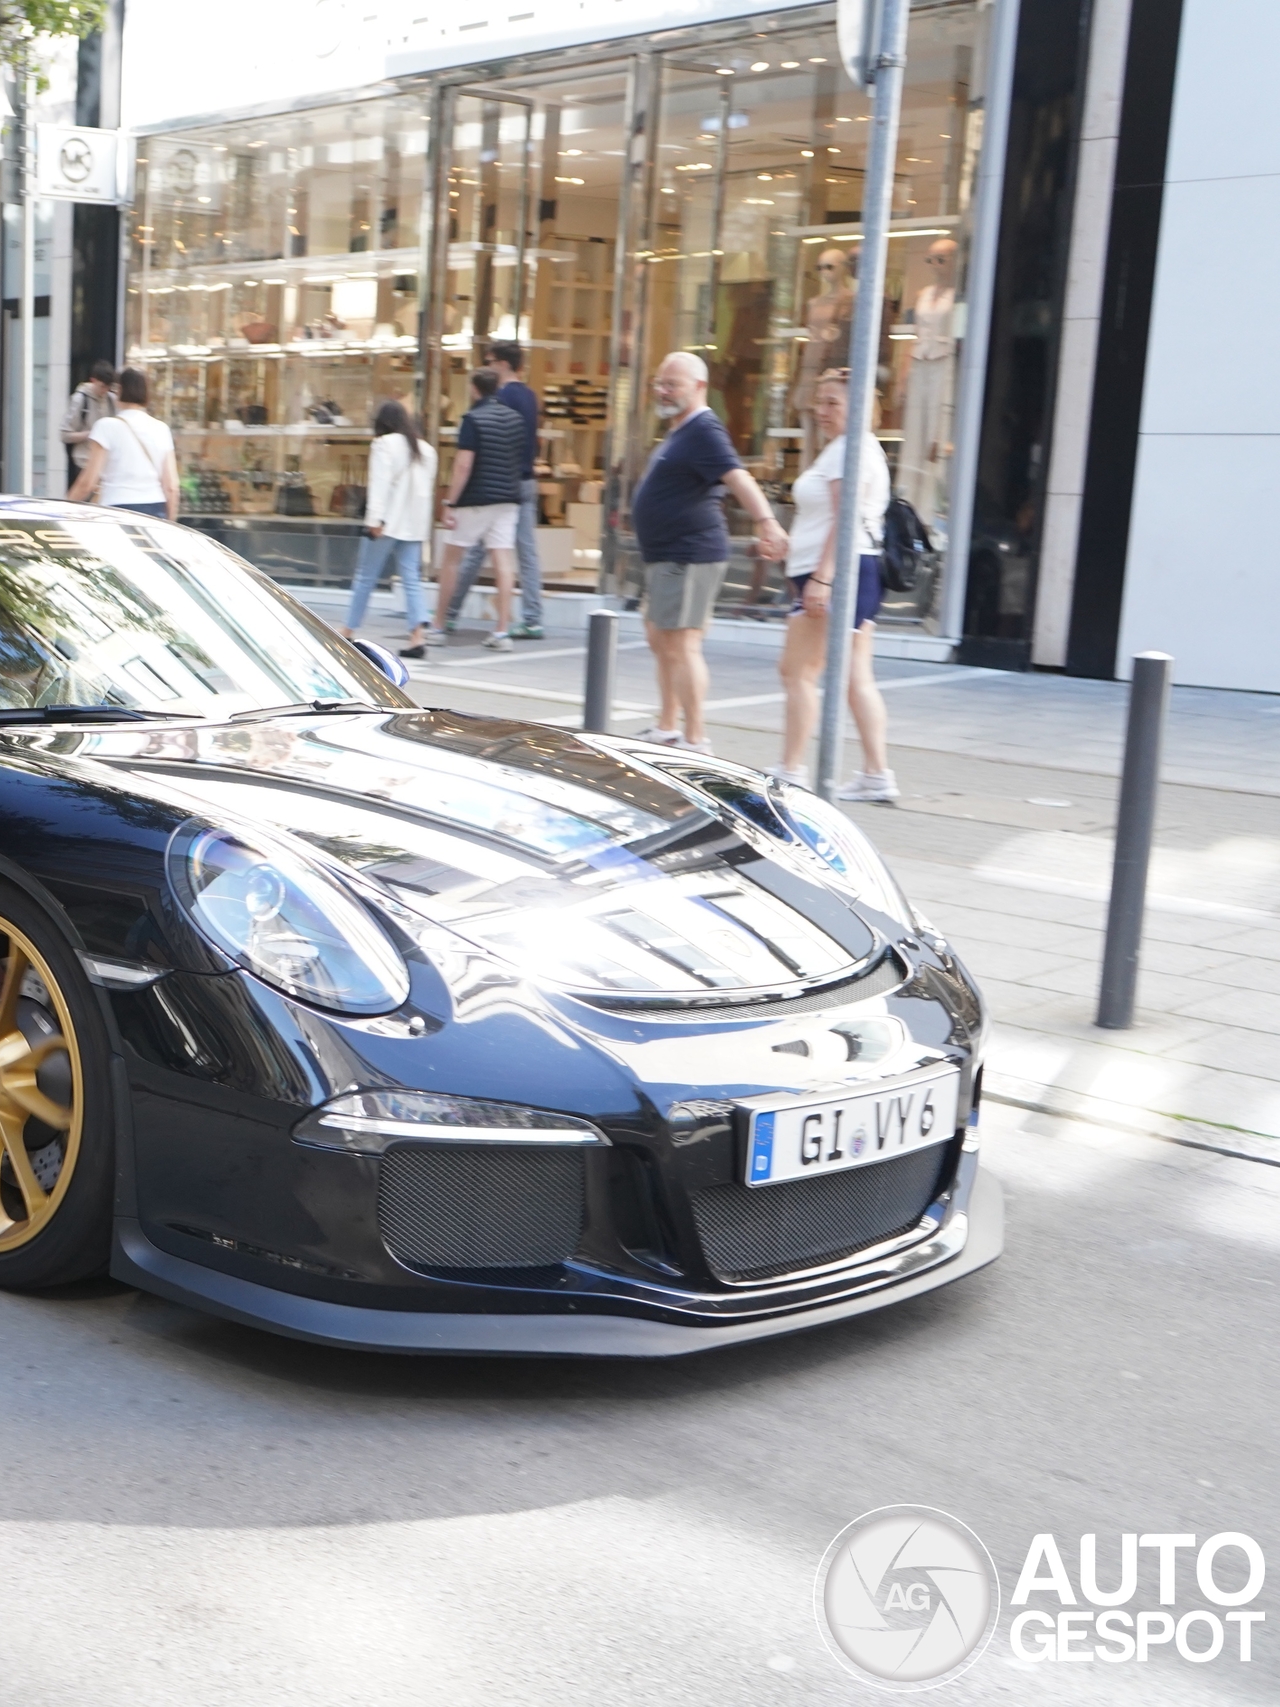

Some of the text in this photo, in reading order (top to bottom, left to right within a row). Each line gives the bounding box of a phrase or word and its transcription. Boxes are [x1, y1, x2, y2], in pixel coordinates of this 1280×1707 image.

[801, 1085, 935, 1166] GI VY 6
